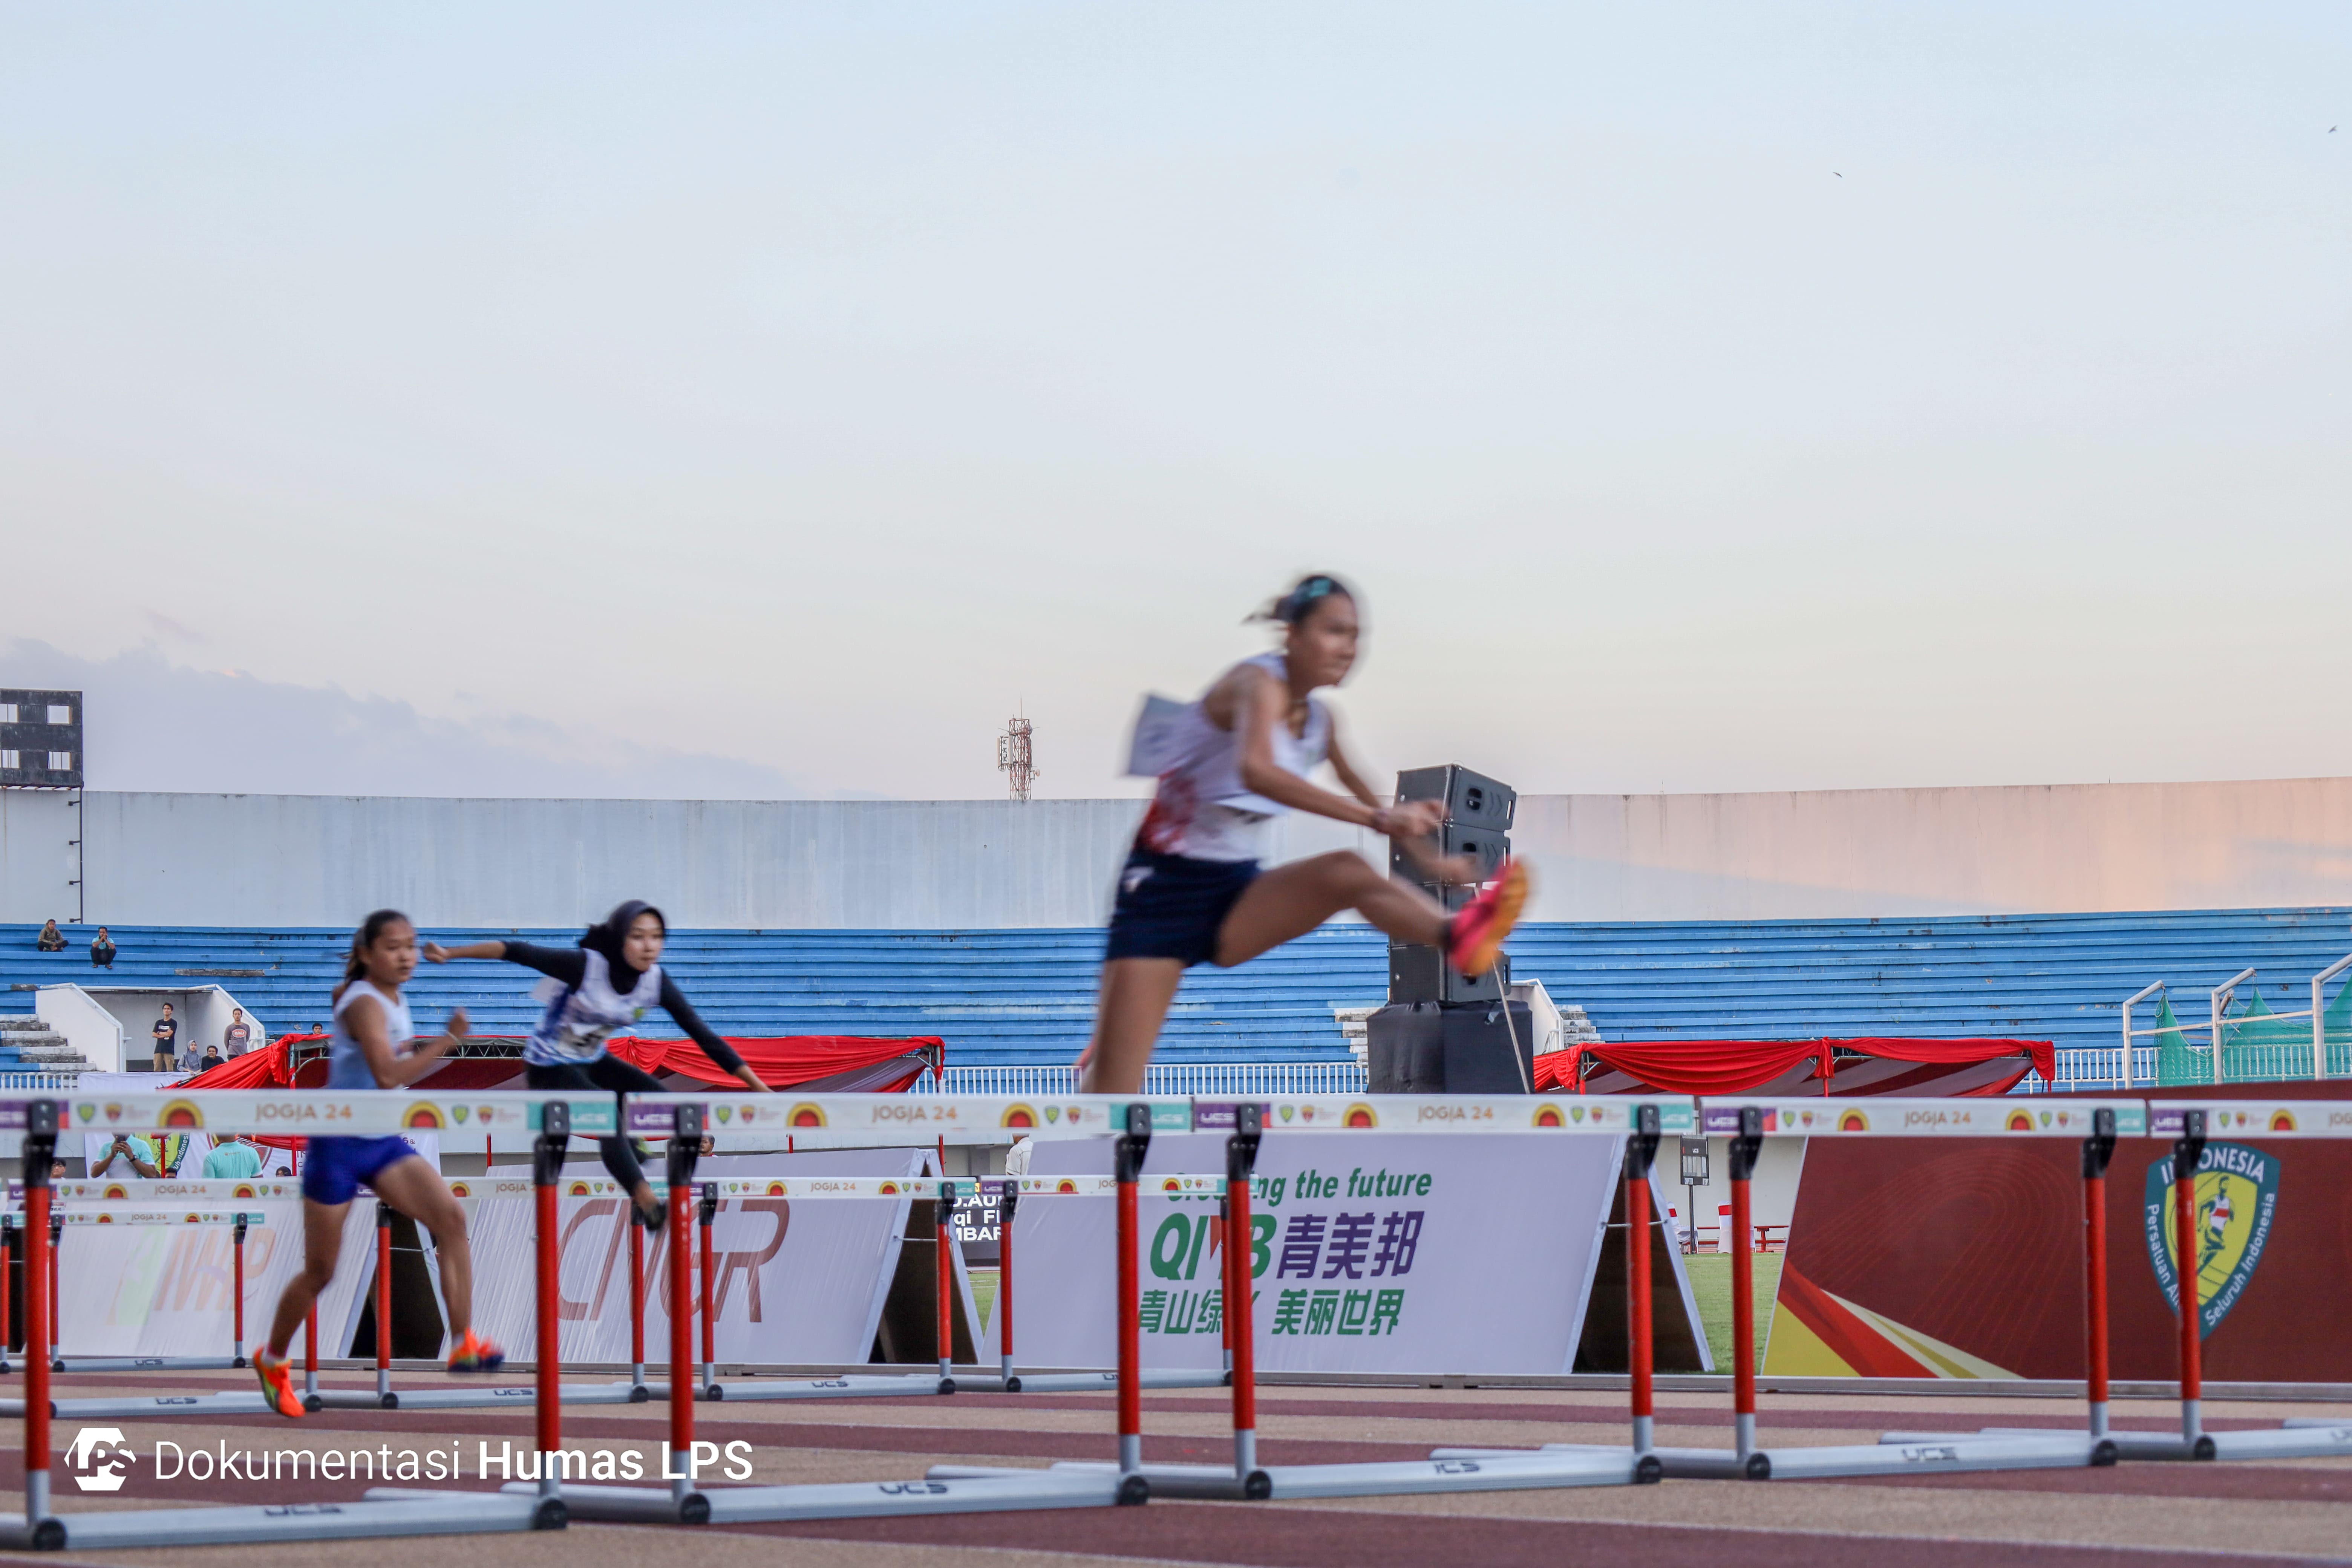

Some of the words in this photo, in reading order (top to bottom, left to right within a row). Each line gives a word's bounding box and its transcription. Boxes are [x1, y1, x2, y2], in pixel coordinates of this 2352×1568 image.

[255, 1104, 316, 1122] JOGJA
[325, 1104, 352, 1119] 24
[634, 1114, 674, 1125] UCS
[871, 1105, 926, 1122] JOGJA
[934, 1106, 957, 1119] 24
[1200, 1113, 1235, 1124] UCS
[1418, 1106, 1465, 1122] JOGJA
[1472, 1106, 1493, 1119] 24
[1905, 1112, 1946, 1126] JOGJA
[1952, 1112, 1971, 1124] 24
[177, 1132, 189, 1161] ndonesi
[155, 1185, 187, 1194] JOGJA
[496, 1183, 526, 1193] JOGJA
[811, 1183, 840, 1192] JOGJA
[1099, 1180, 1117, 1189] JOG
[1295, 1169, 1338, 1198] the
[1347, 1167, 1432, 1197] future
[953, 1210, 972, 1227] qi
[1277, 1211, 1425, 1280] 青美邦
[2148, 1204, 2171, 1284] Persatuan
[2205, 1276, 2246, 1326] Seluruh
[2241, 1193, 2275, 1272] Indonesia
[1138, 1289, 1260, 1334] 青山绿
[1272, 1288, 1405, 1335] 美丽世界
[879, 1483, 948, 1494] UCS
